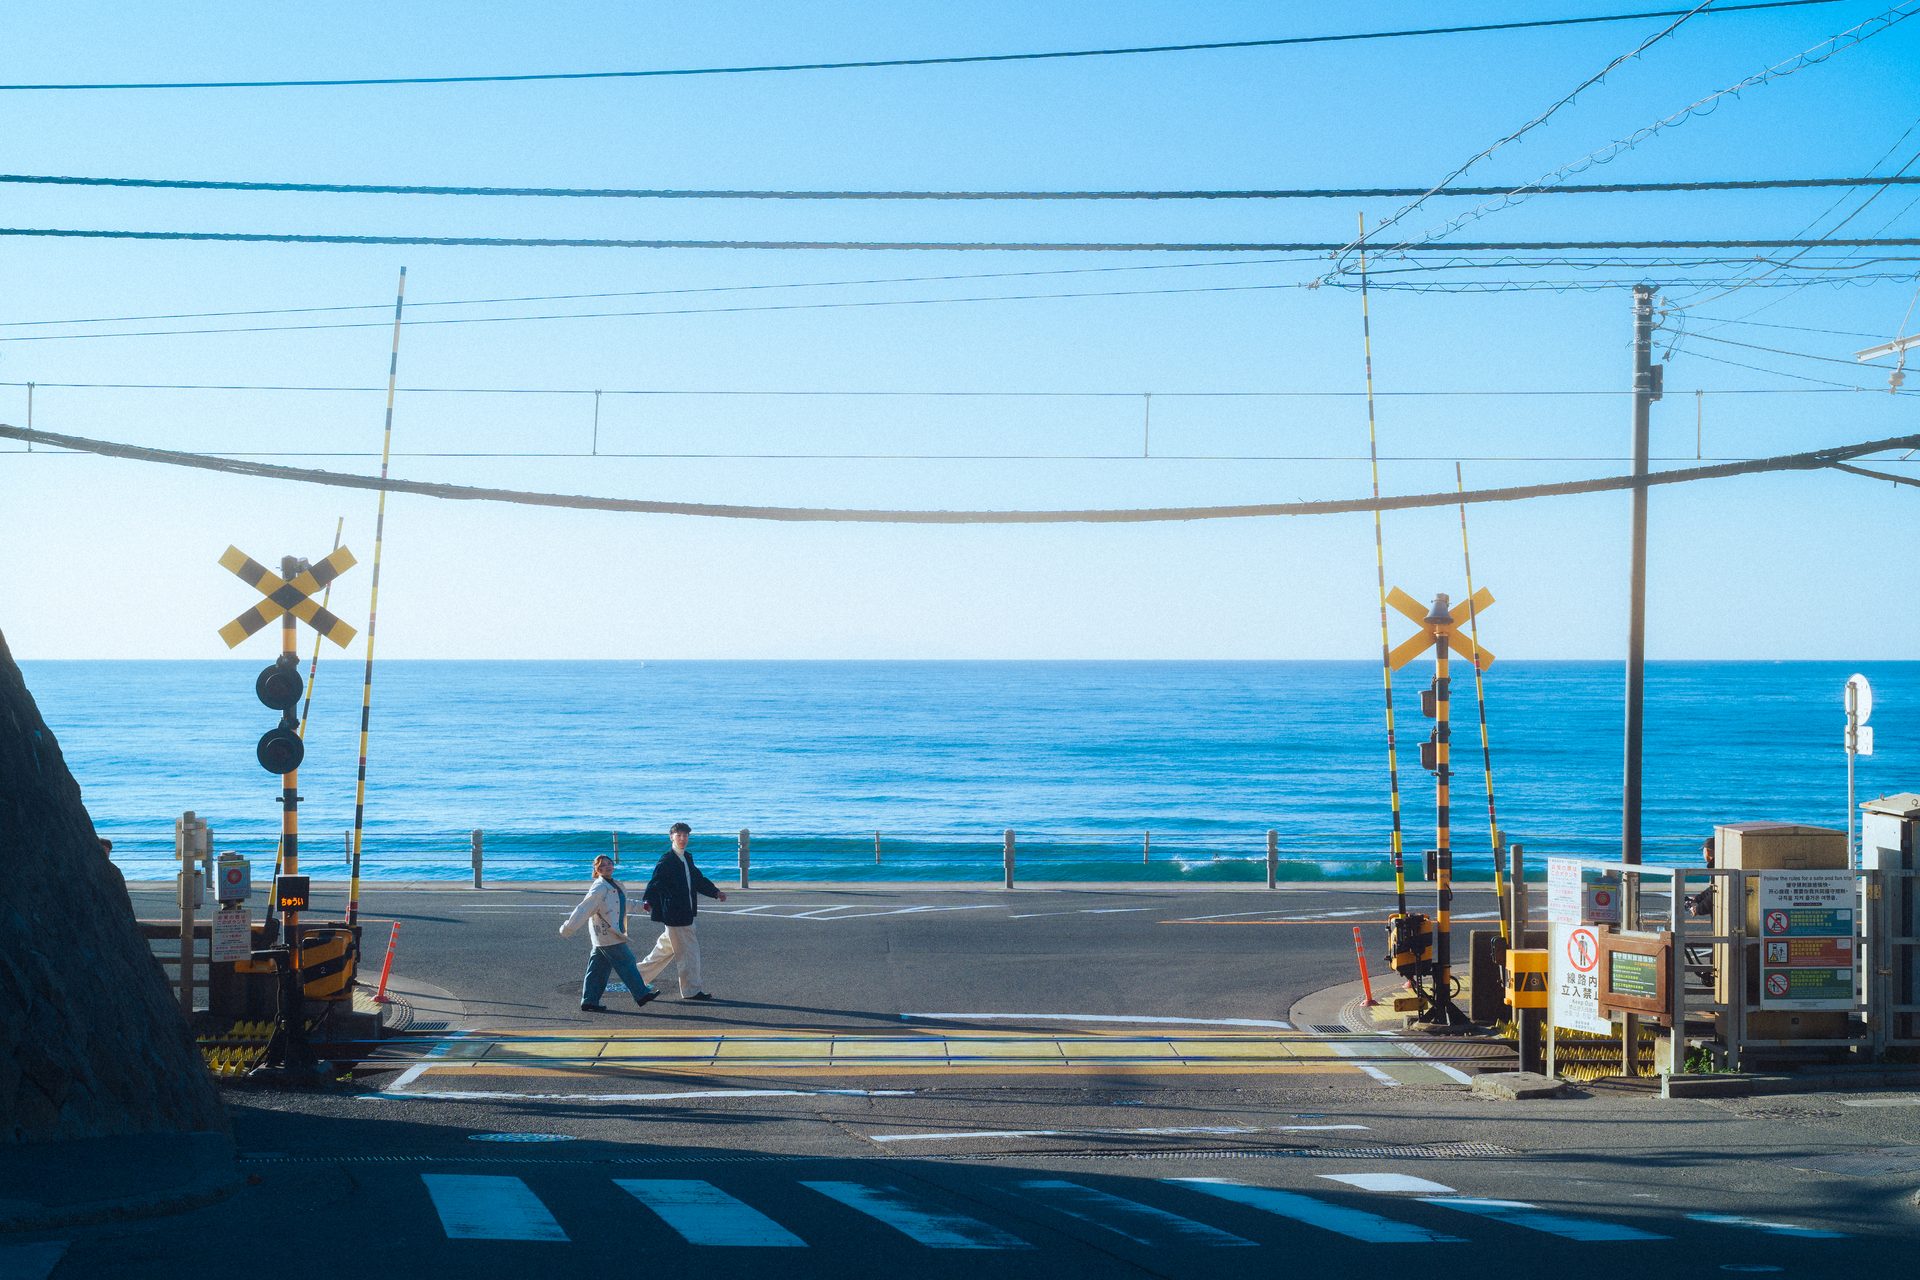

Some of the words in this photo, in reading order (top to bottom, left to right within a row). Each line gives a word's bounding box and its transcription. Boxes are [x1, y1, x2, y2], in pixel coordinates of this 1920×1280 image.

[281, 897, 304, 907] ちゅうい
[320, 966, 327, 974] 2
[1567, 972, 1598, 988] 線路内
